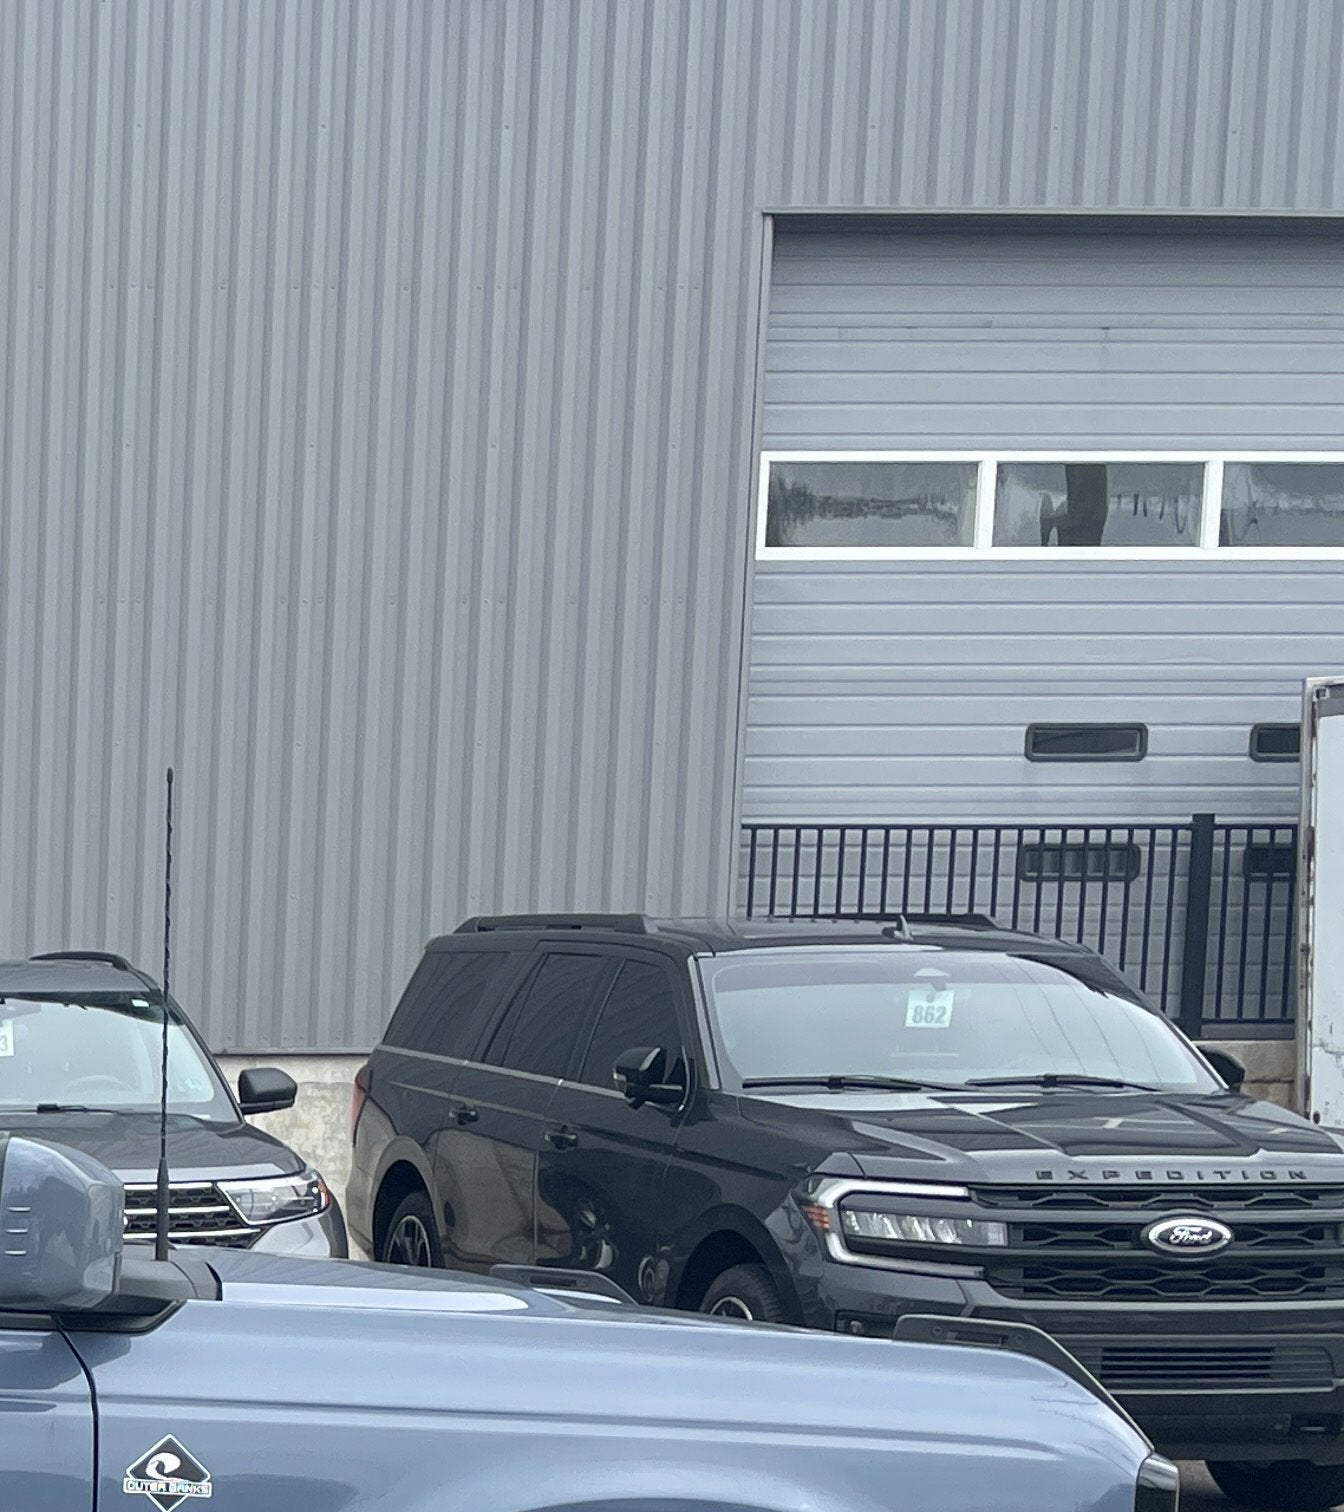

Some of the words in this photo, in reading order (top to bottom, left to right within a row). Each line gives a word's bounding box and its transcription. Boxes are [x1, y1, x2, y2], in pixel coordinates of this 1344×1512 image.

[912, 1005, 947, 1024] 862
[1035, 1169, 1309, 1181] EXPEDITION
[1169, 1225, 1214, 1245] Ford
[127, 1480, 167, 1492] OUTER
[169, 1482, 209, 1494] BANKS
